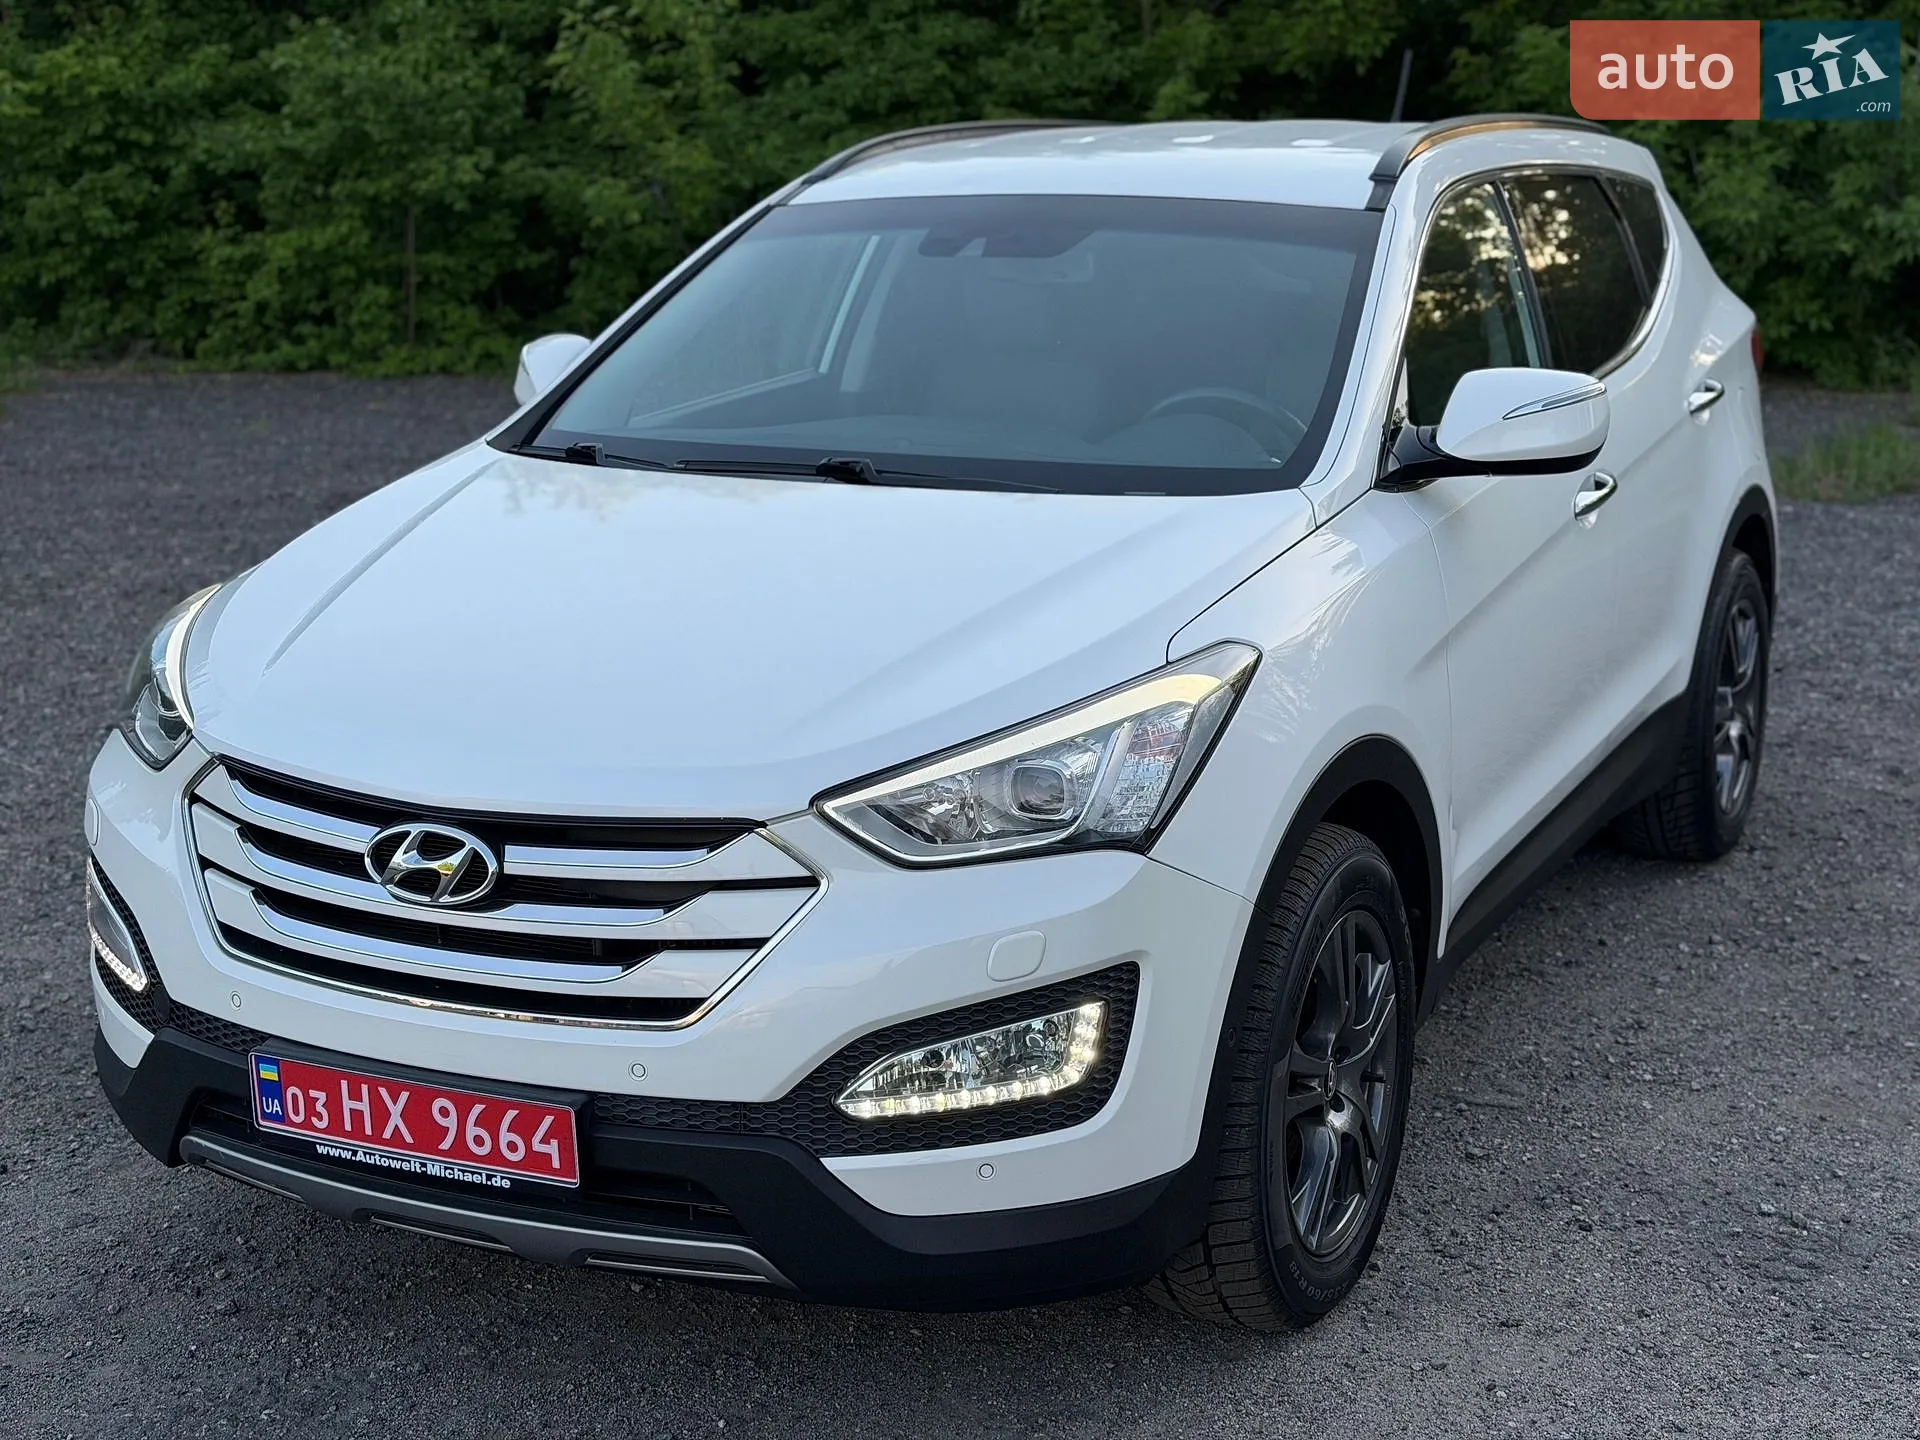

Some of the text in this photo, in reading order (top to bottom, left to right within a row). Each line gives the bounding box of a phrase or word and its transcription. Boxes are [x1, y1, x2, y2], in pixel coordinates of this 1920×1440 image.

[262, 1097, 283, 1116] UA
[287, 1080, 561, 1169] 03 HX 9664
[316, 1143, 511, 1188] www.Autowelt-Michael.de
